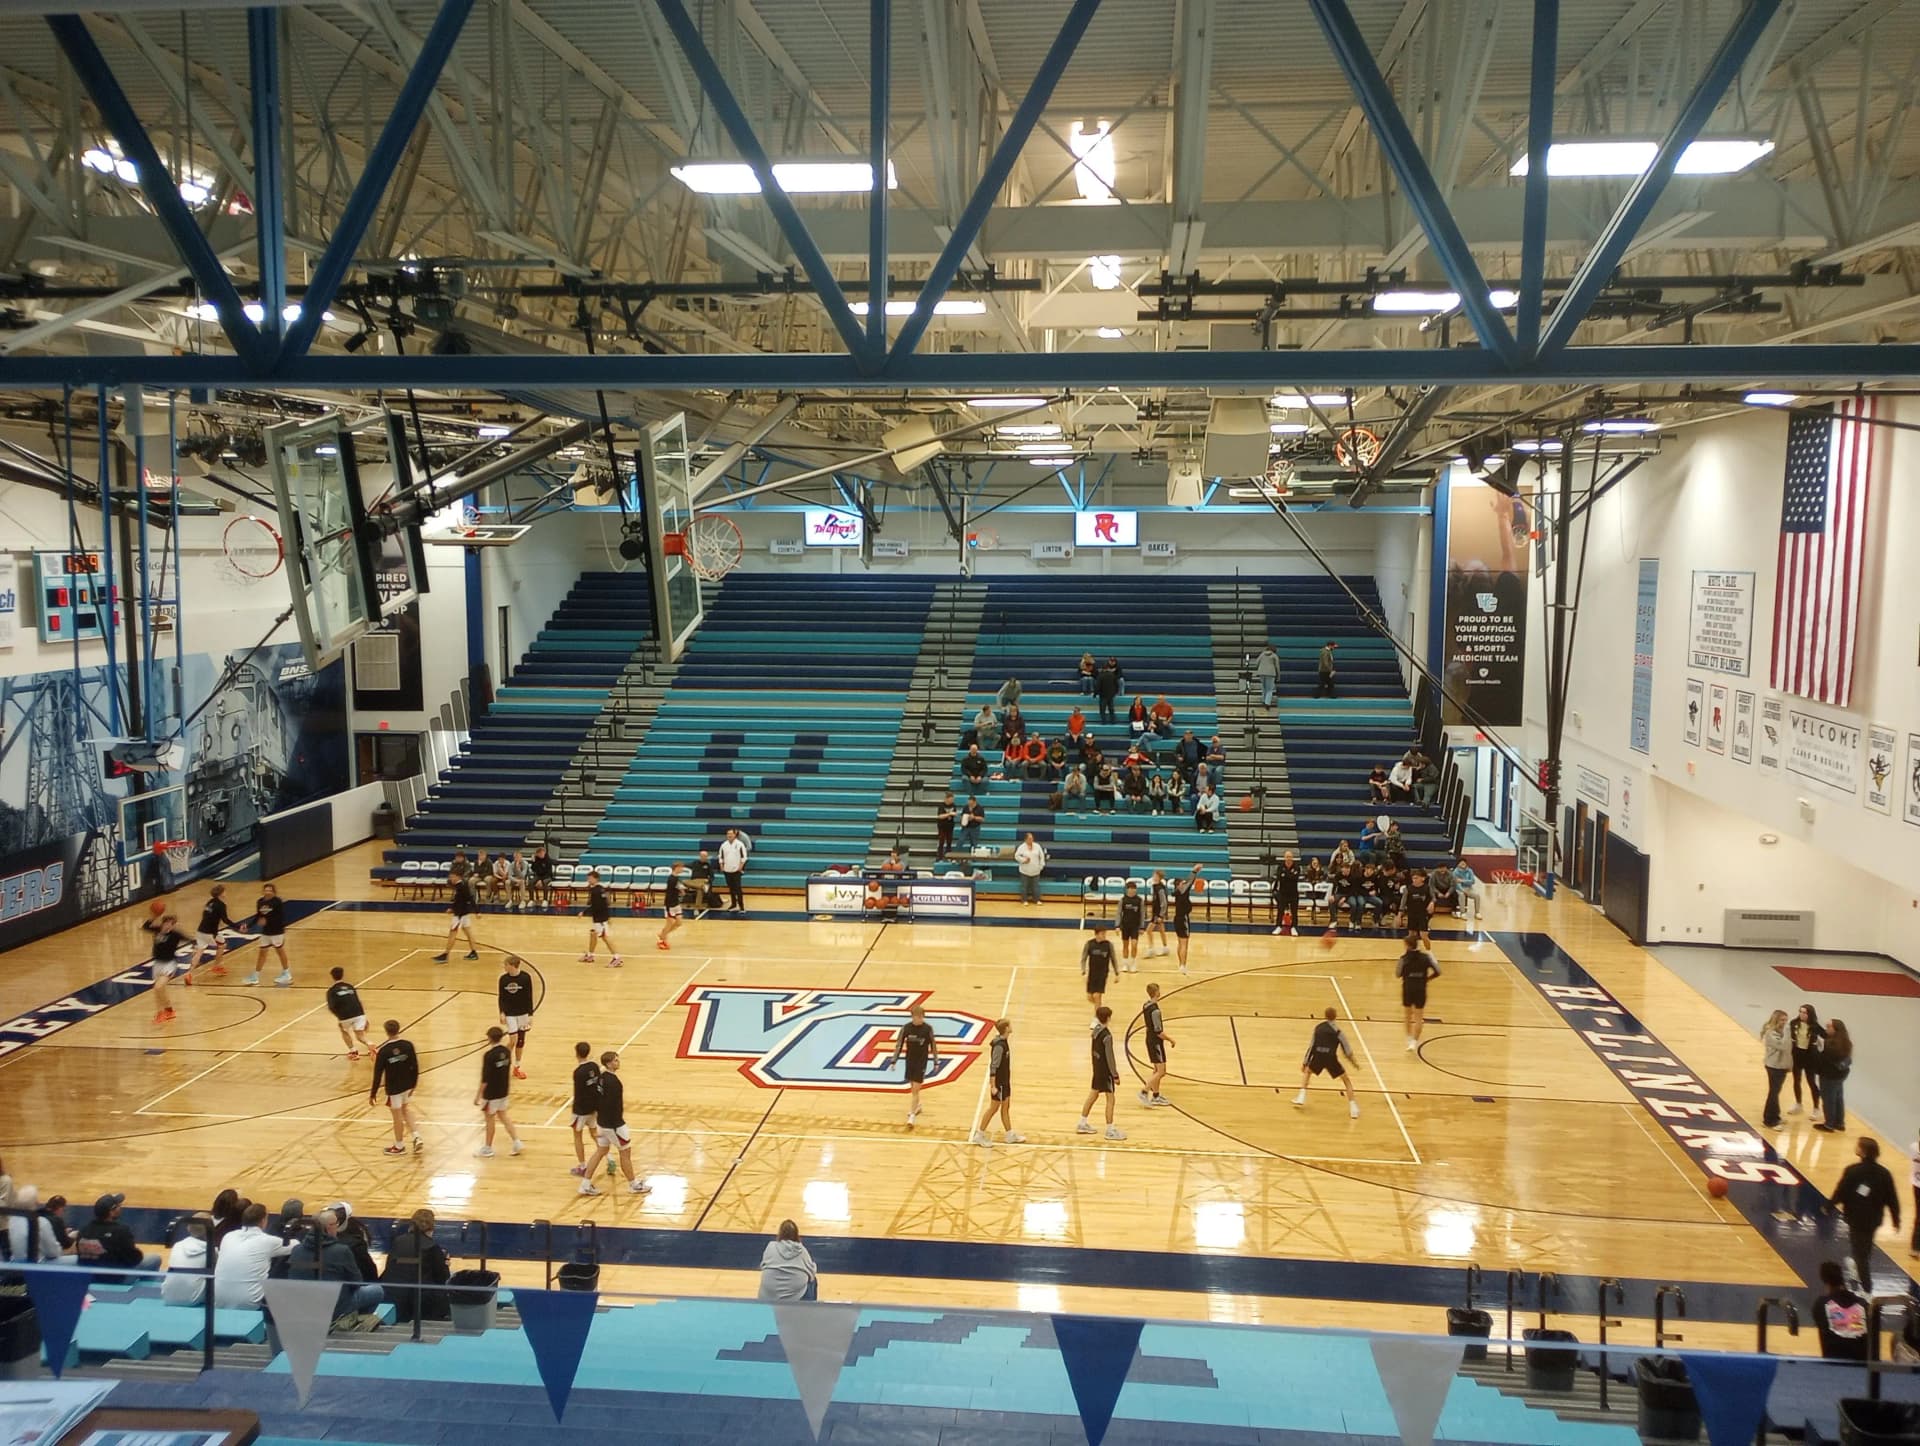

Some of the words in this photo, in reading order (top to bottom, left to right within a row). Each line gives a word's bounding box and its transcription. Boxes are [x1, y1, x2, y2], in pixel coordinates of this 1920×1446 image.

[1148, 543, 1169, 552] OAKES
[375, 573, 407, 583] PIRED
[1458, 615, 1487, 623] PROUD
[1489, 615, 1501, 623] TO
[1503, 615, 1514, 623] BE
[1454, 625, 1478, 633] YOUR
[1479, 625, 1517, 633] OFFICIAL
[1455, 635, 1515, 643] ORTHOPEDICS
[1453, 654, 1493, 662] MEDICINE
[1495, 654, 1518, 662] TEAM
[280, 664, 309, 675] BNS
[1791, 715, 1857, 749] WELCOME
[0, 862, 64, 922] ERS
[912, 895, 940, 905] ACOTAH
[941, 896, 962, 905] BANK
